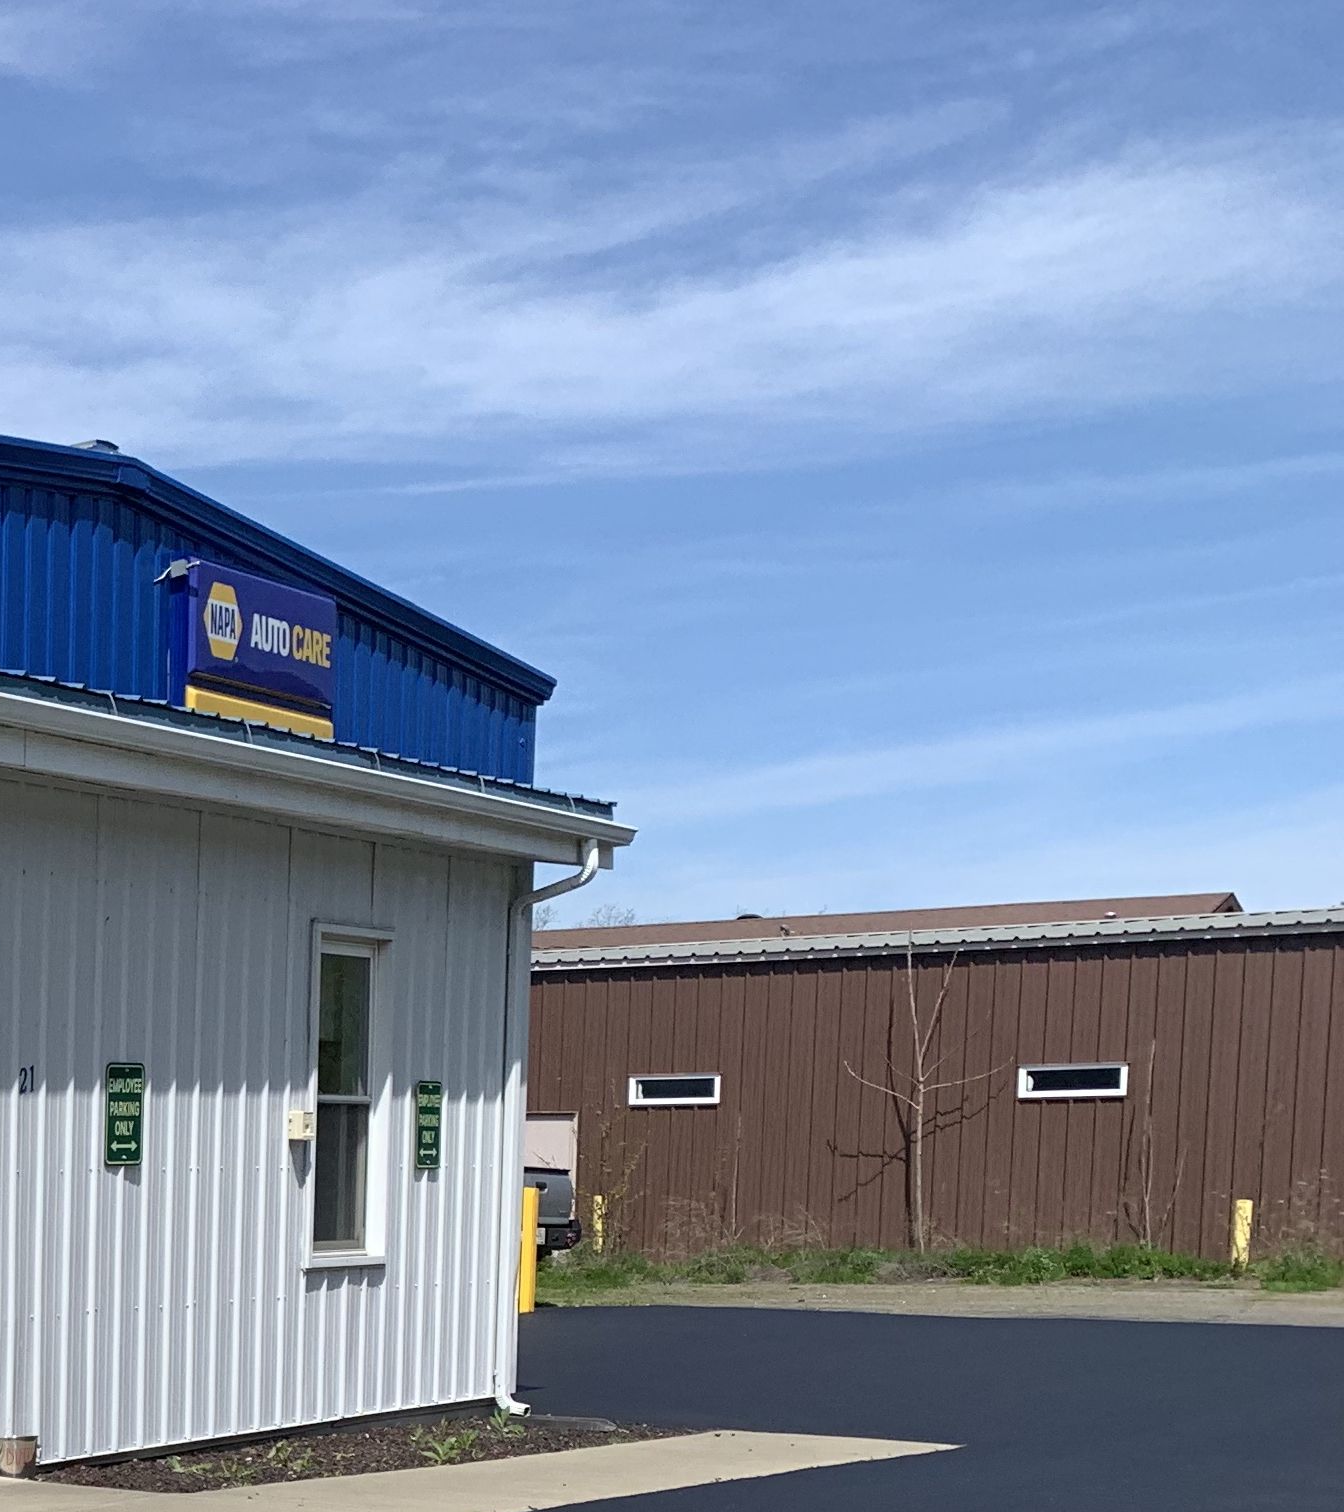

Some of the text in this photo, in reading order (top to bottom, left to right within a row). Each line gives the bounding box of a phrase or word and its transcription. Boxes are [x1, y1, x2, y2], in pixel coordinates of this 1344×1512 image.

[210, 603, 331, 669] NAPA AUTO CARE
[18, 1065, 35, 1095] 21
[108, 1078, 142, 1093] EMPLOYEE
[109, 1101, 140, 1117] PARKING
[114, 1120, 135, 1136] ONLY
